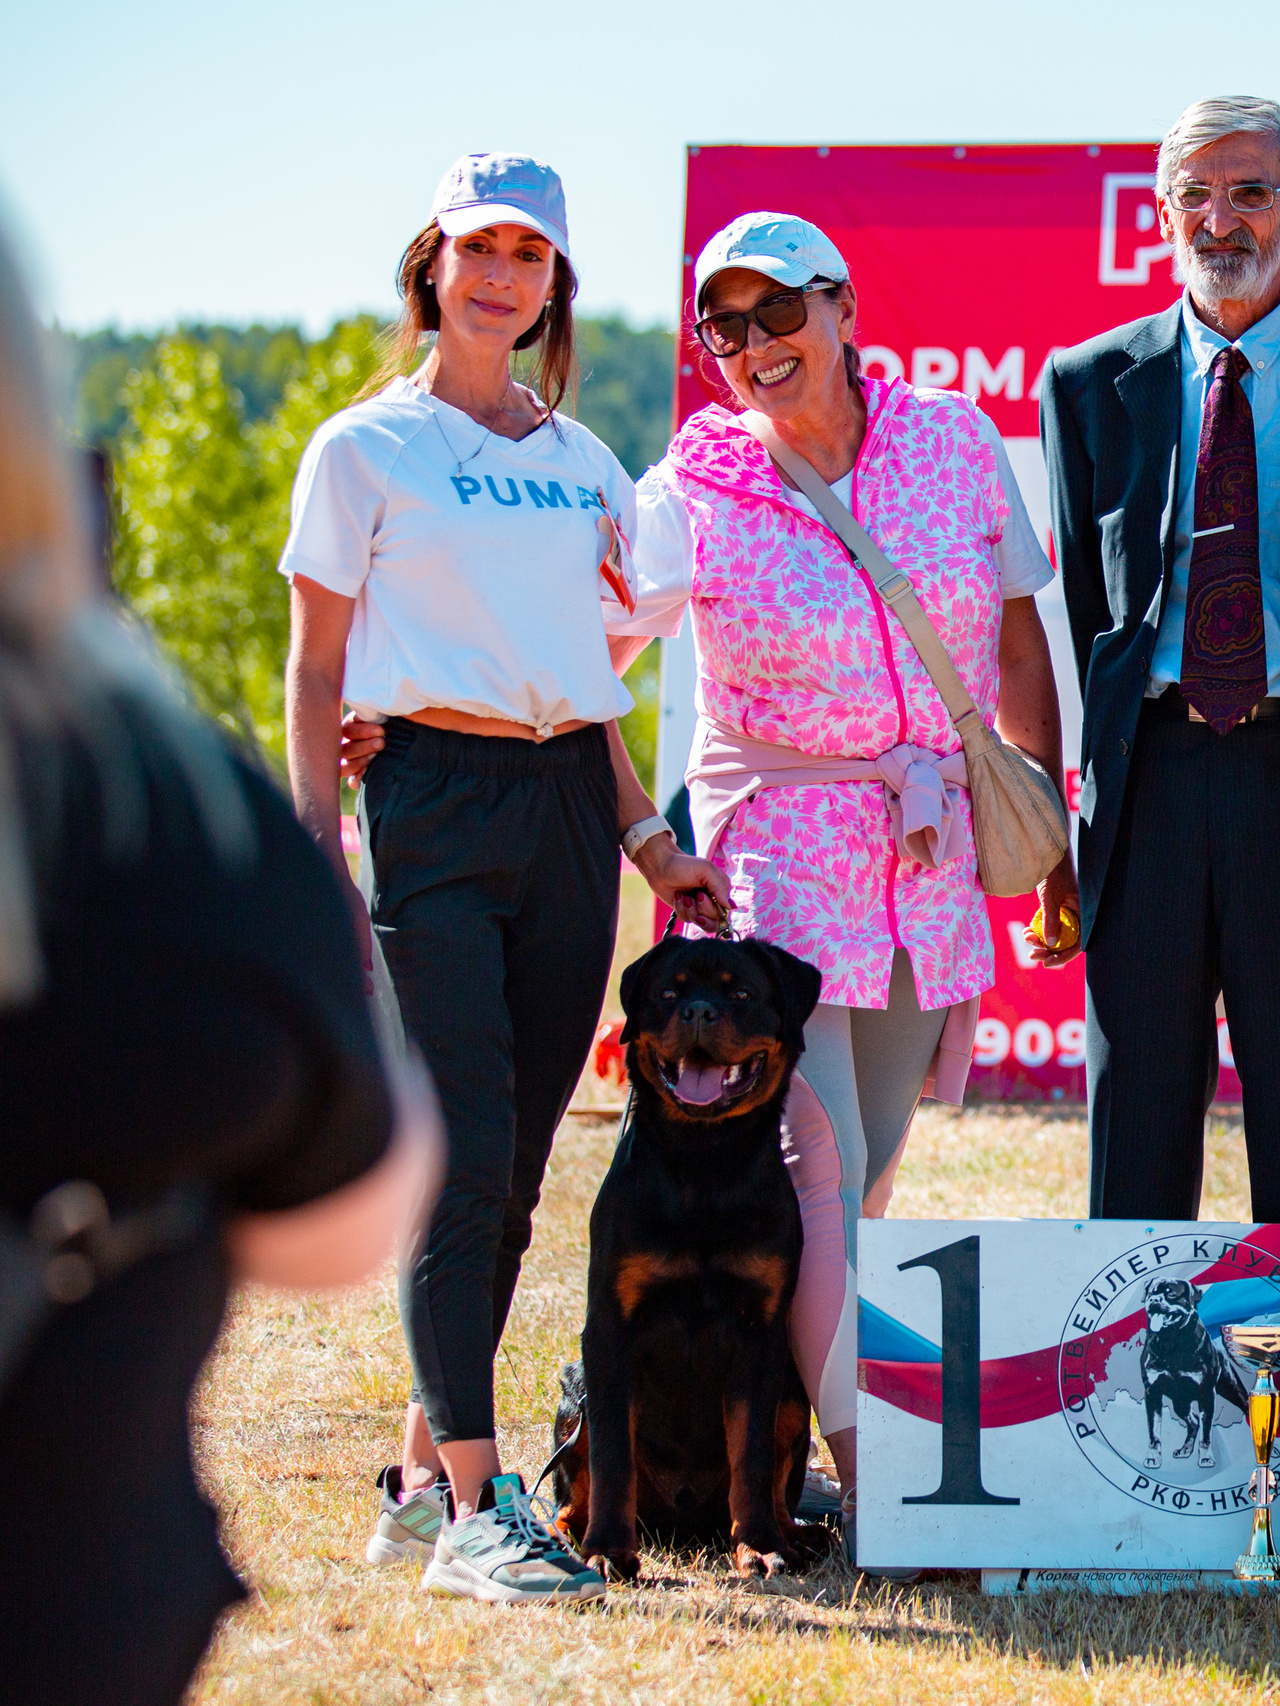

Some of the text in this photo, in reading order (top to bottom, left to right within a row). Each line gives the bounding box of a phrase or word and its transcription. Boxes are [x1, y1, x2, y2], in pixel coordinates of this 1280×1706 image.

[450, 474, 605, 510] PUMA
[897, 1235, 1021, 1505] 1
[1063, 1244, 1171, 1440] РОТВЕЙЛЕР
[1036, 1570, 1079, 1582] Корма
[1082, 1571, 1127, 1581] нового
